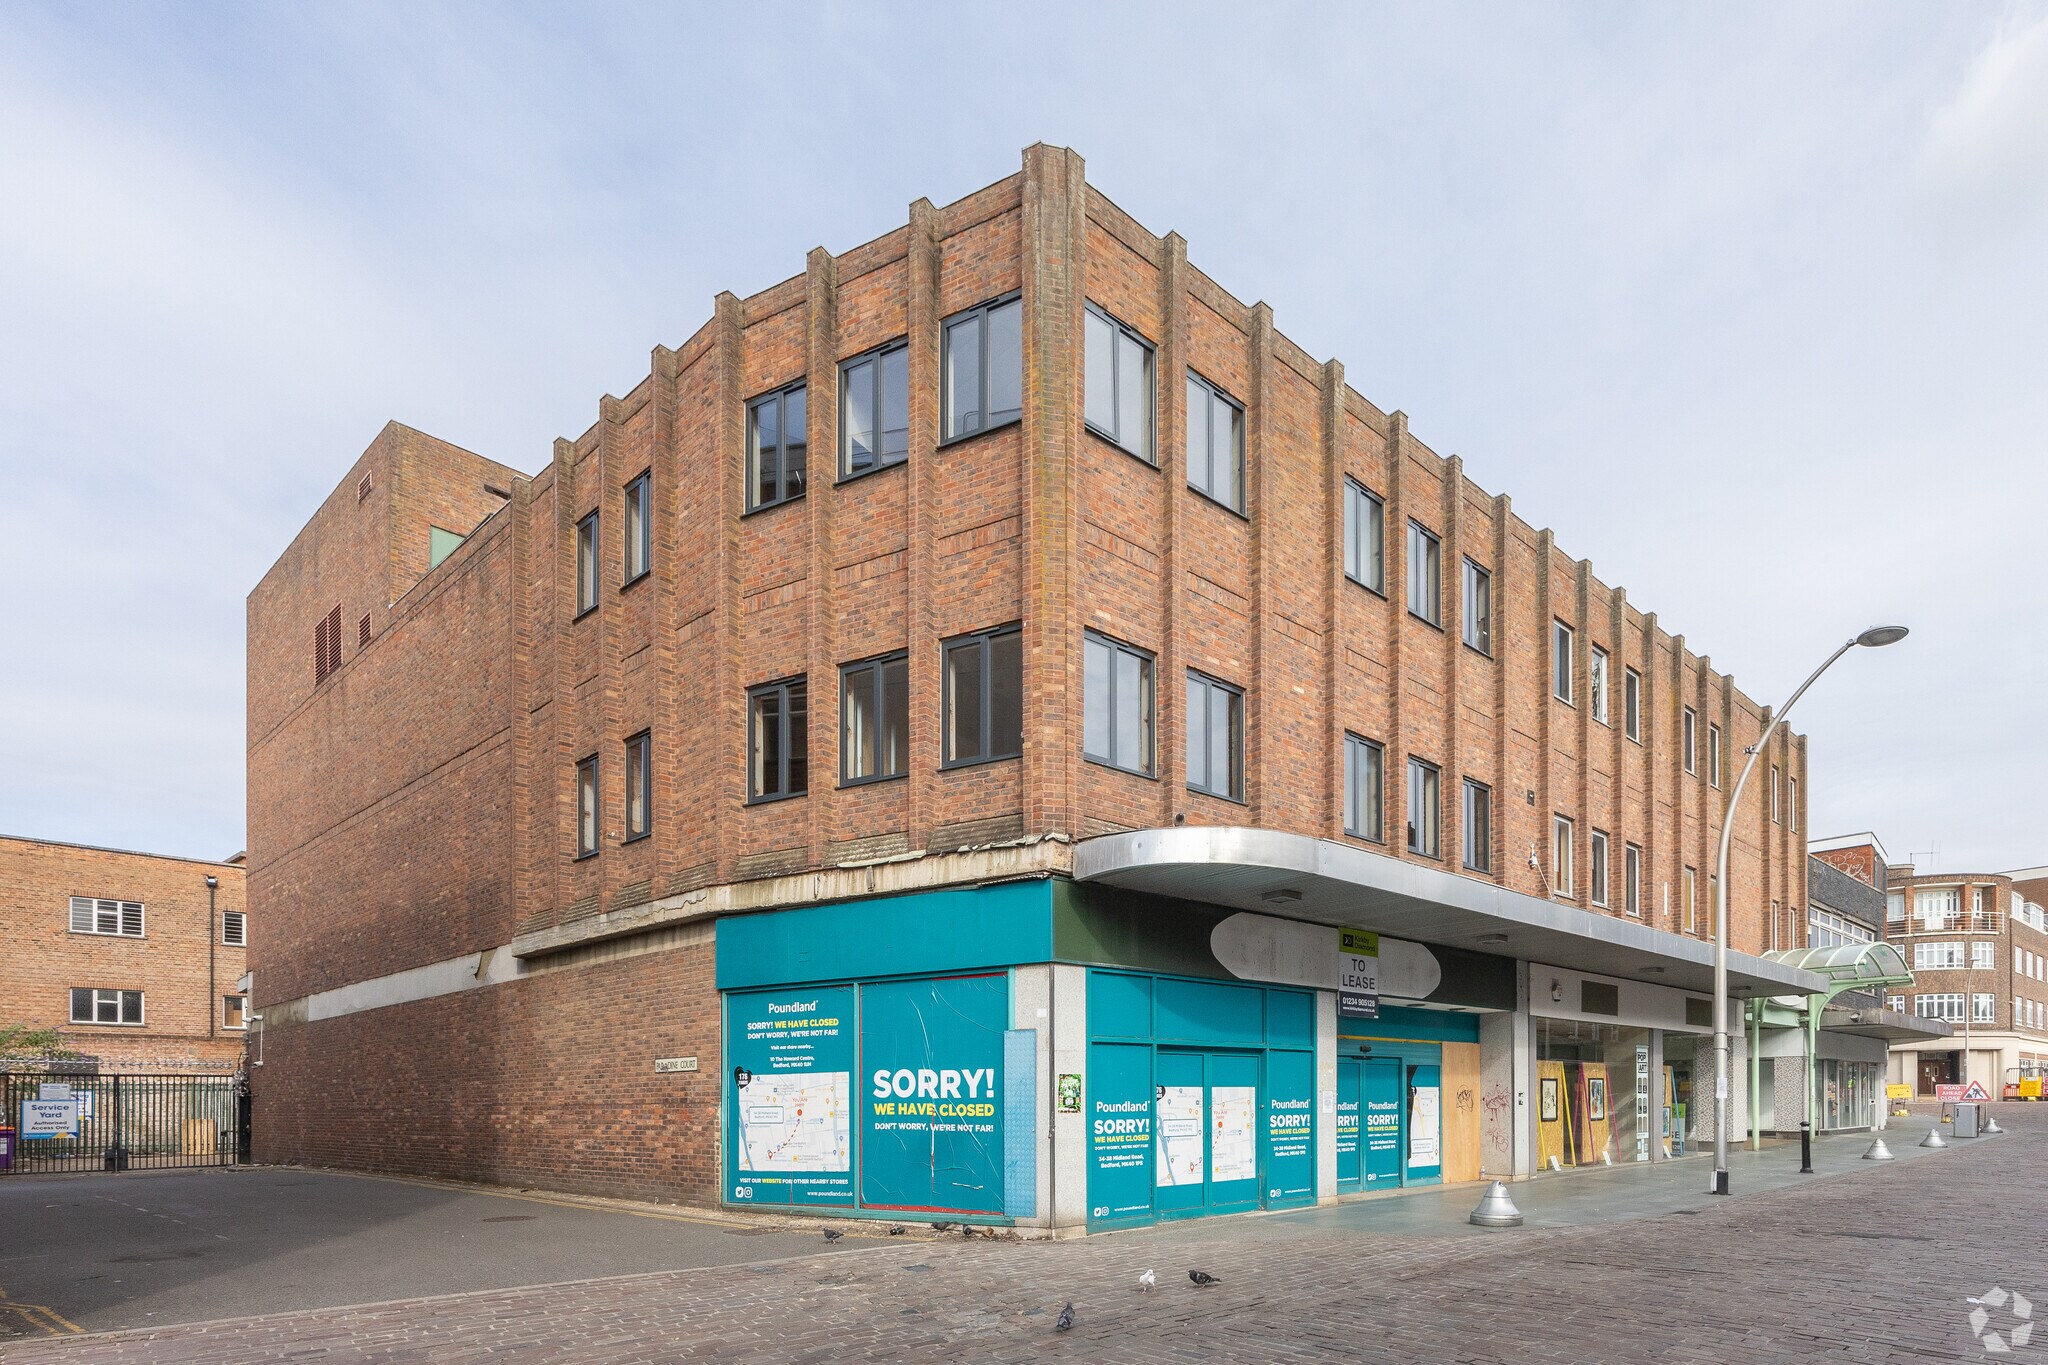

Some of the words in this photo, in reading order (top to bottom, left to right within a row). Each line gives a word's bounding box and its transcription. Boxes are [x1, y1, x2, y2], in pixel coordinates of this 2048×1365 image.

[1352, 959, 1365, 972] TO
[1342, 974, 1375, 990] LEASE
[1343, 997, 1358, 1005] 01234
[768, 1001, 816, 1013] Poundland
[747, 1022, 773, 1030] SORRY!
[788, 1020, 808, 1028] HAVE
[810, 1018, 839, 1027] CLOSED
[873, 1069, 994, 1098] SORRY!
[873, 1103, 895, 1115] WE
[898, 1103, 936, 1116] HAVE
[940, 1104, 994, 1116] CLOSED
[1096, 1101, 1148, 1112] Poundland
[1272, 1099, 1309, 1109] Poundland
[1338, 1102, 1357, 1110] ndland
[1368, 1102, 1397, 1110] Poundland
[1270, 1114, 1310, 1128] SORRY!
[1338, 1115, 1358, 1126] RRY!
[1367, 1114, 1398, 1125] SORRY!
[898, 1123, 928, 1131] WORRY,
[930, 1123, 955, 1131] WE'RE
[957, 1124, 974, 1132] NOT
[1094, 1119, 1150, 1135] SORRY!
